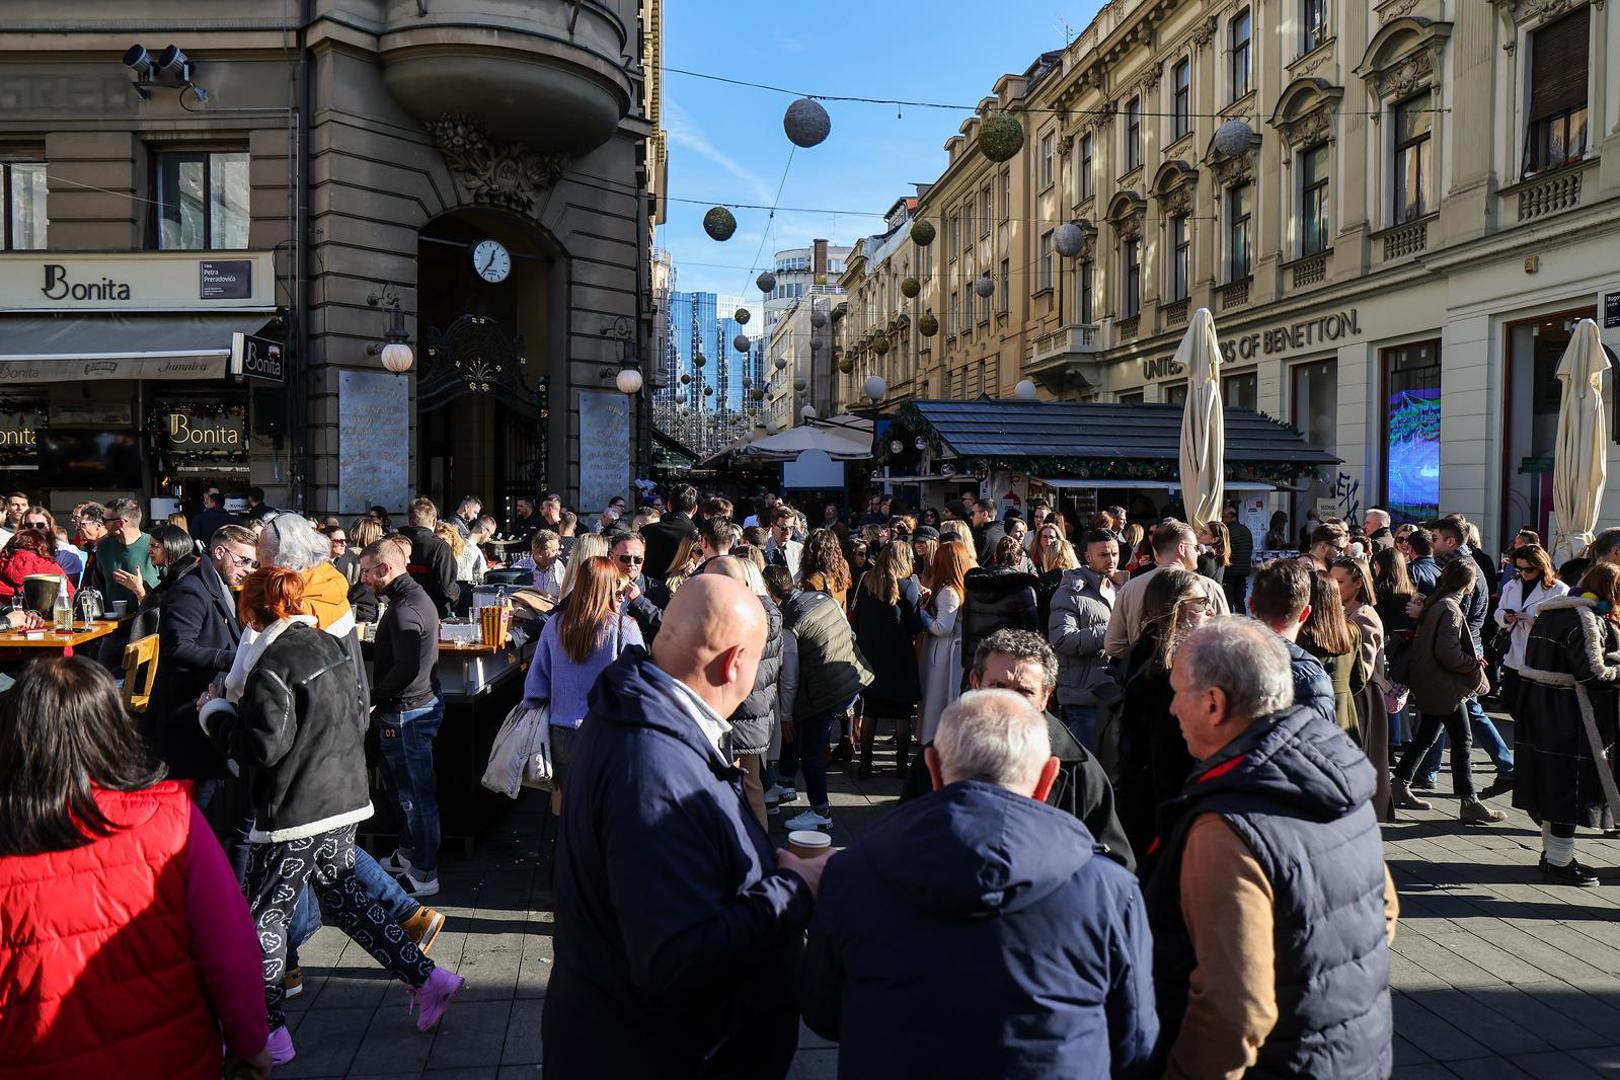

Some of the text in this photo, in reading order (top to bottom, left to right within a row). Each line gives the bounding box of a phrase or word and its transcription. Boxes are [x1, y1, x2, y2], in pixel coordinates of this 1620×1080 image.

[41, 264, 131, 300] Bonita
[245, 341, 281, 375] Bonita
[1239, 333, 1260, 360] OF
[0, 427, 37, 445] onita
[169, 413, 238, 444] Bonita
